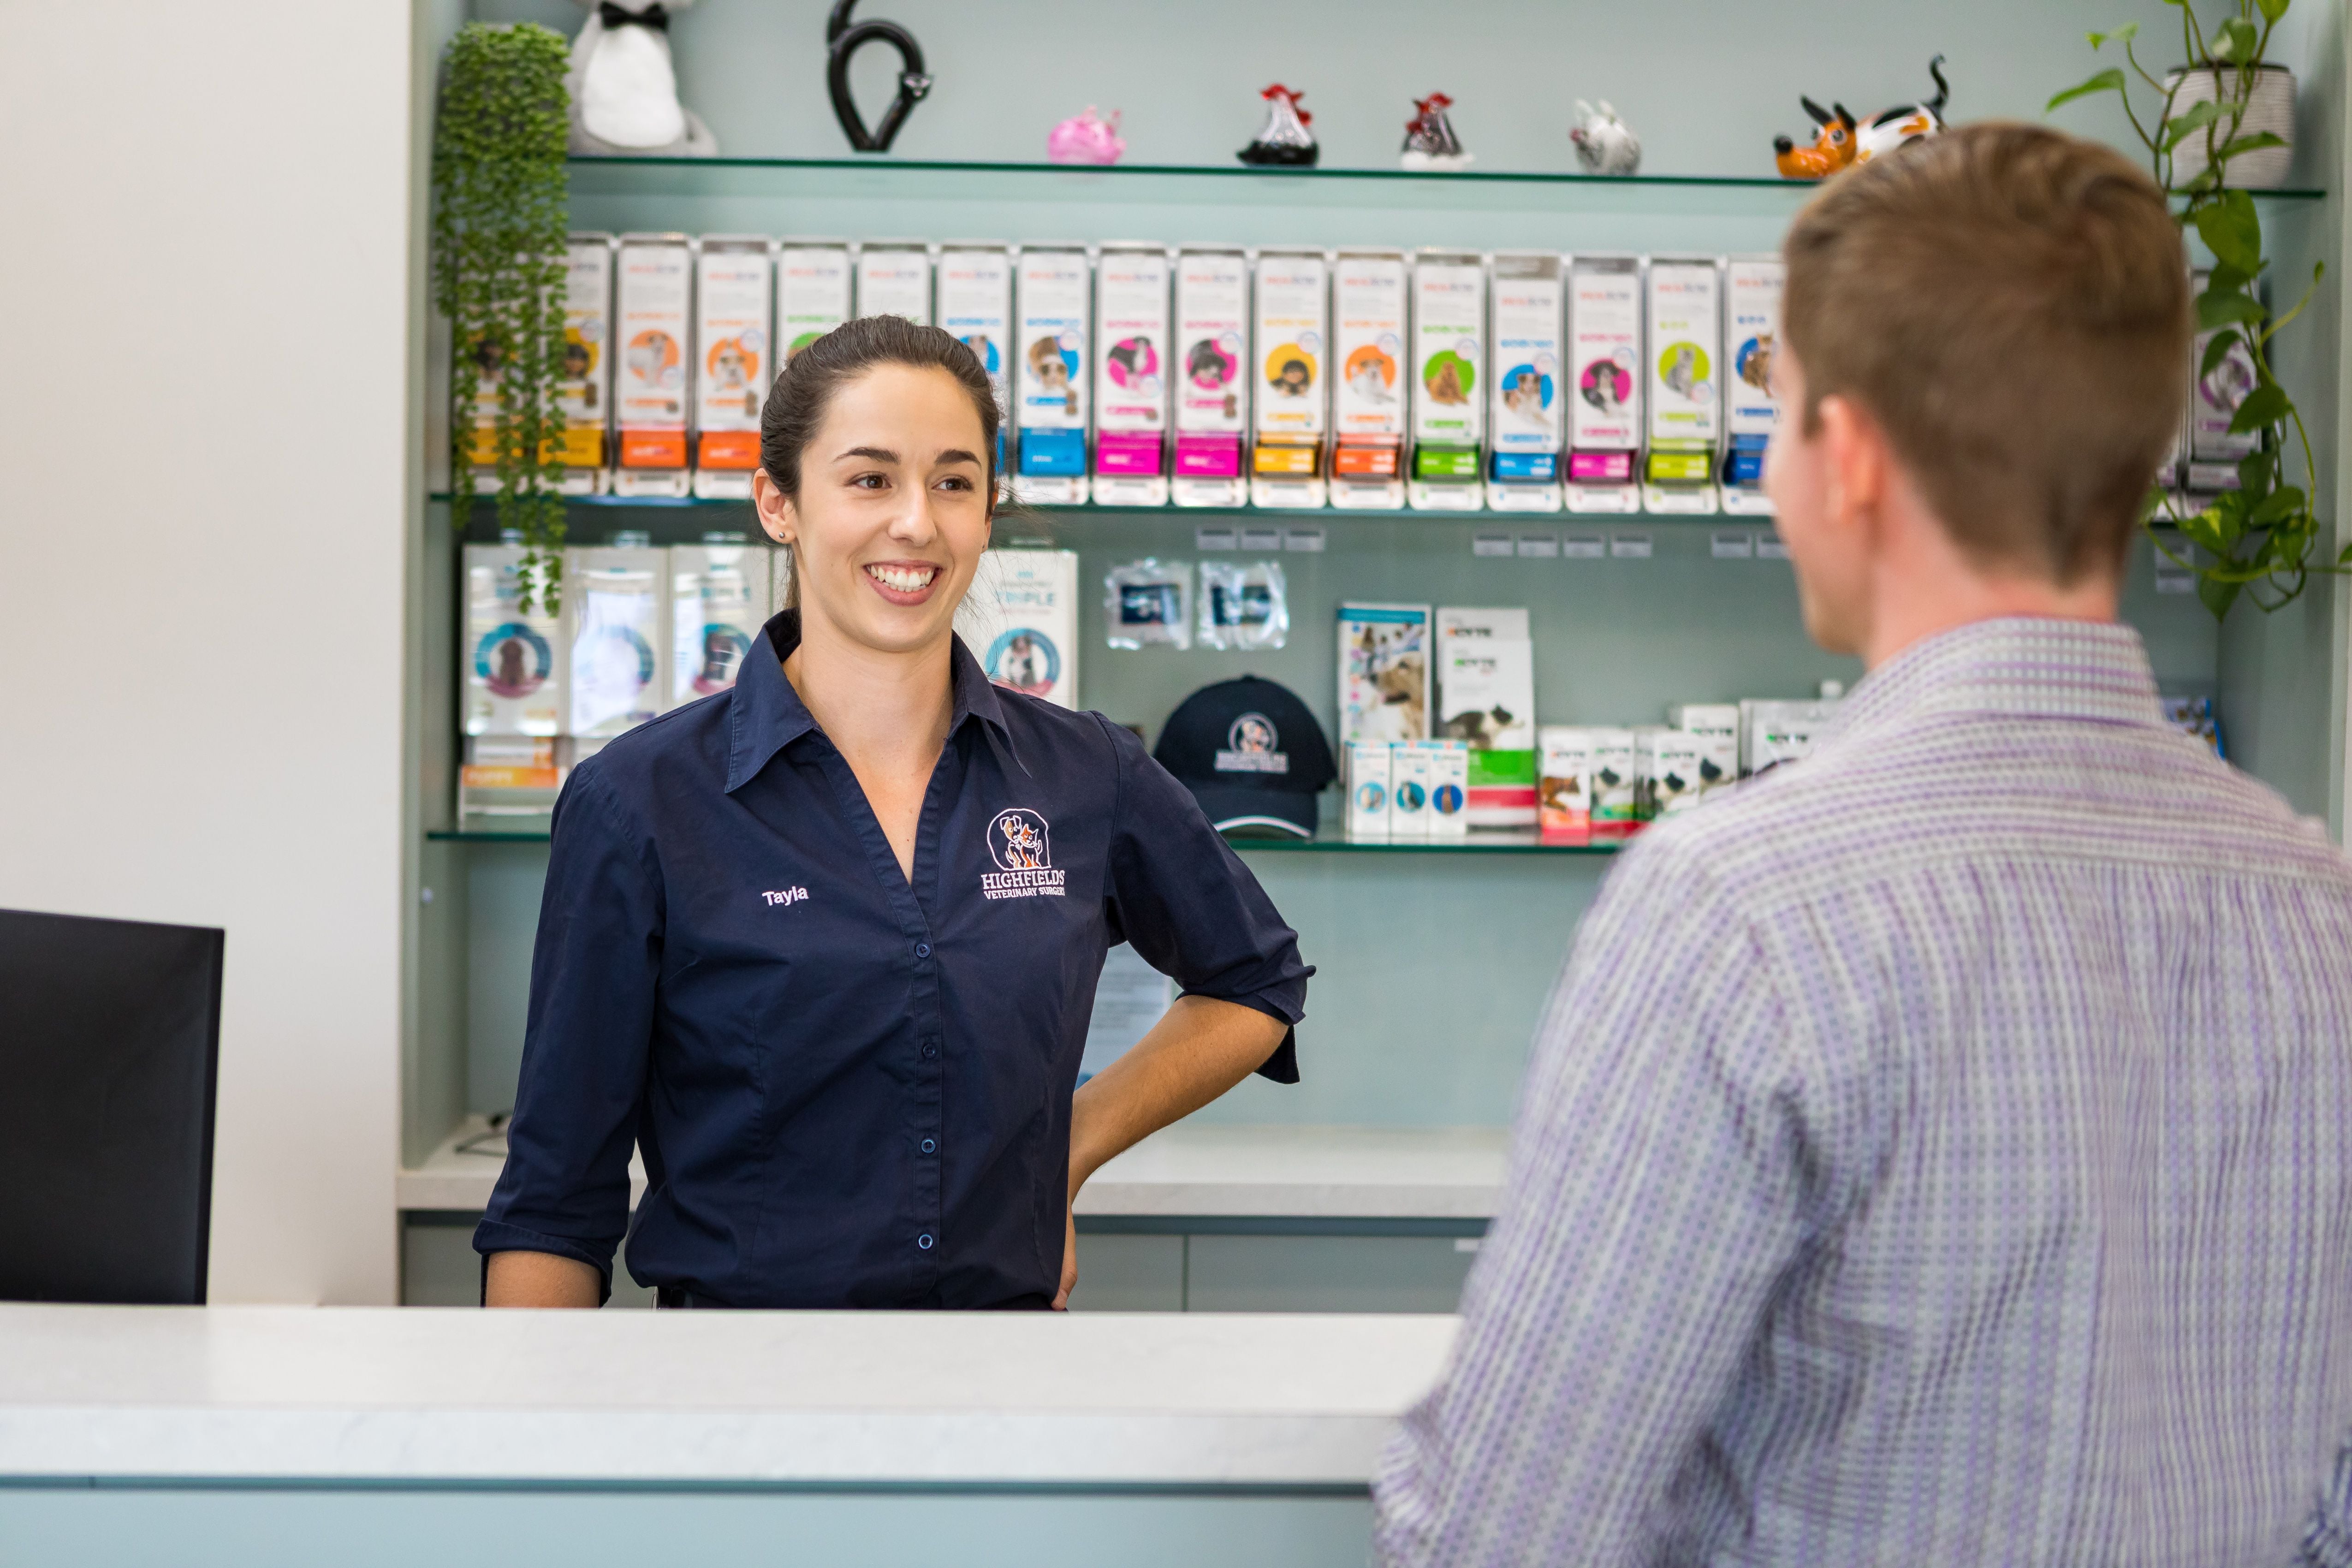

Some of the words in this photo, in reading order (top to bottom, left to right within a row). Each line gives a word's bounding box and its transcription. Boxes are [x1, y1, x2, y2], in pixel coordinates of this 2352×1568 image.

[981, 870, 1065, 889] HIGHFIELDS
[762, 886, 809, 906] Tayla
[984, 888, 1038, 900] VETERINARY
